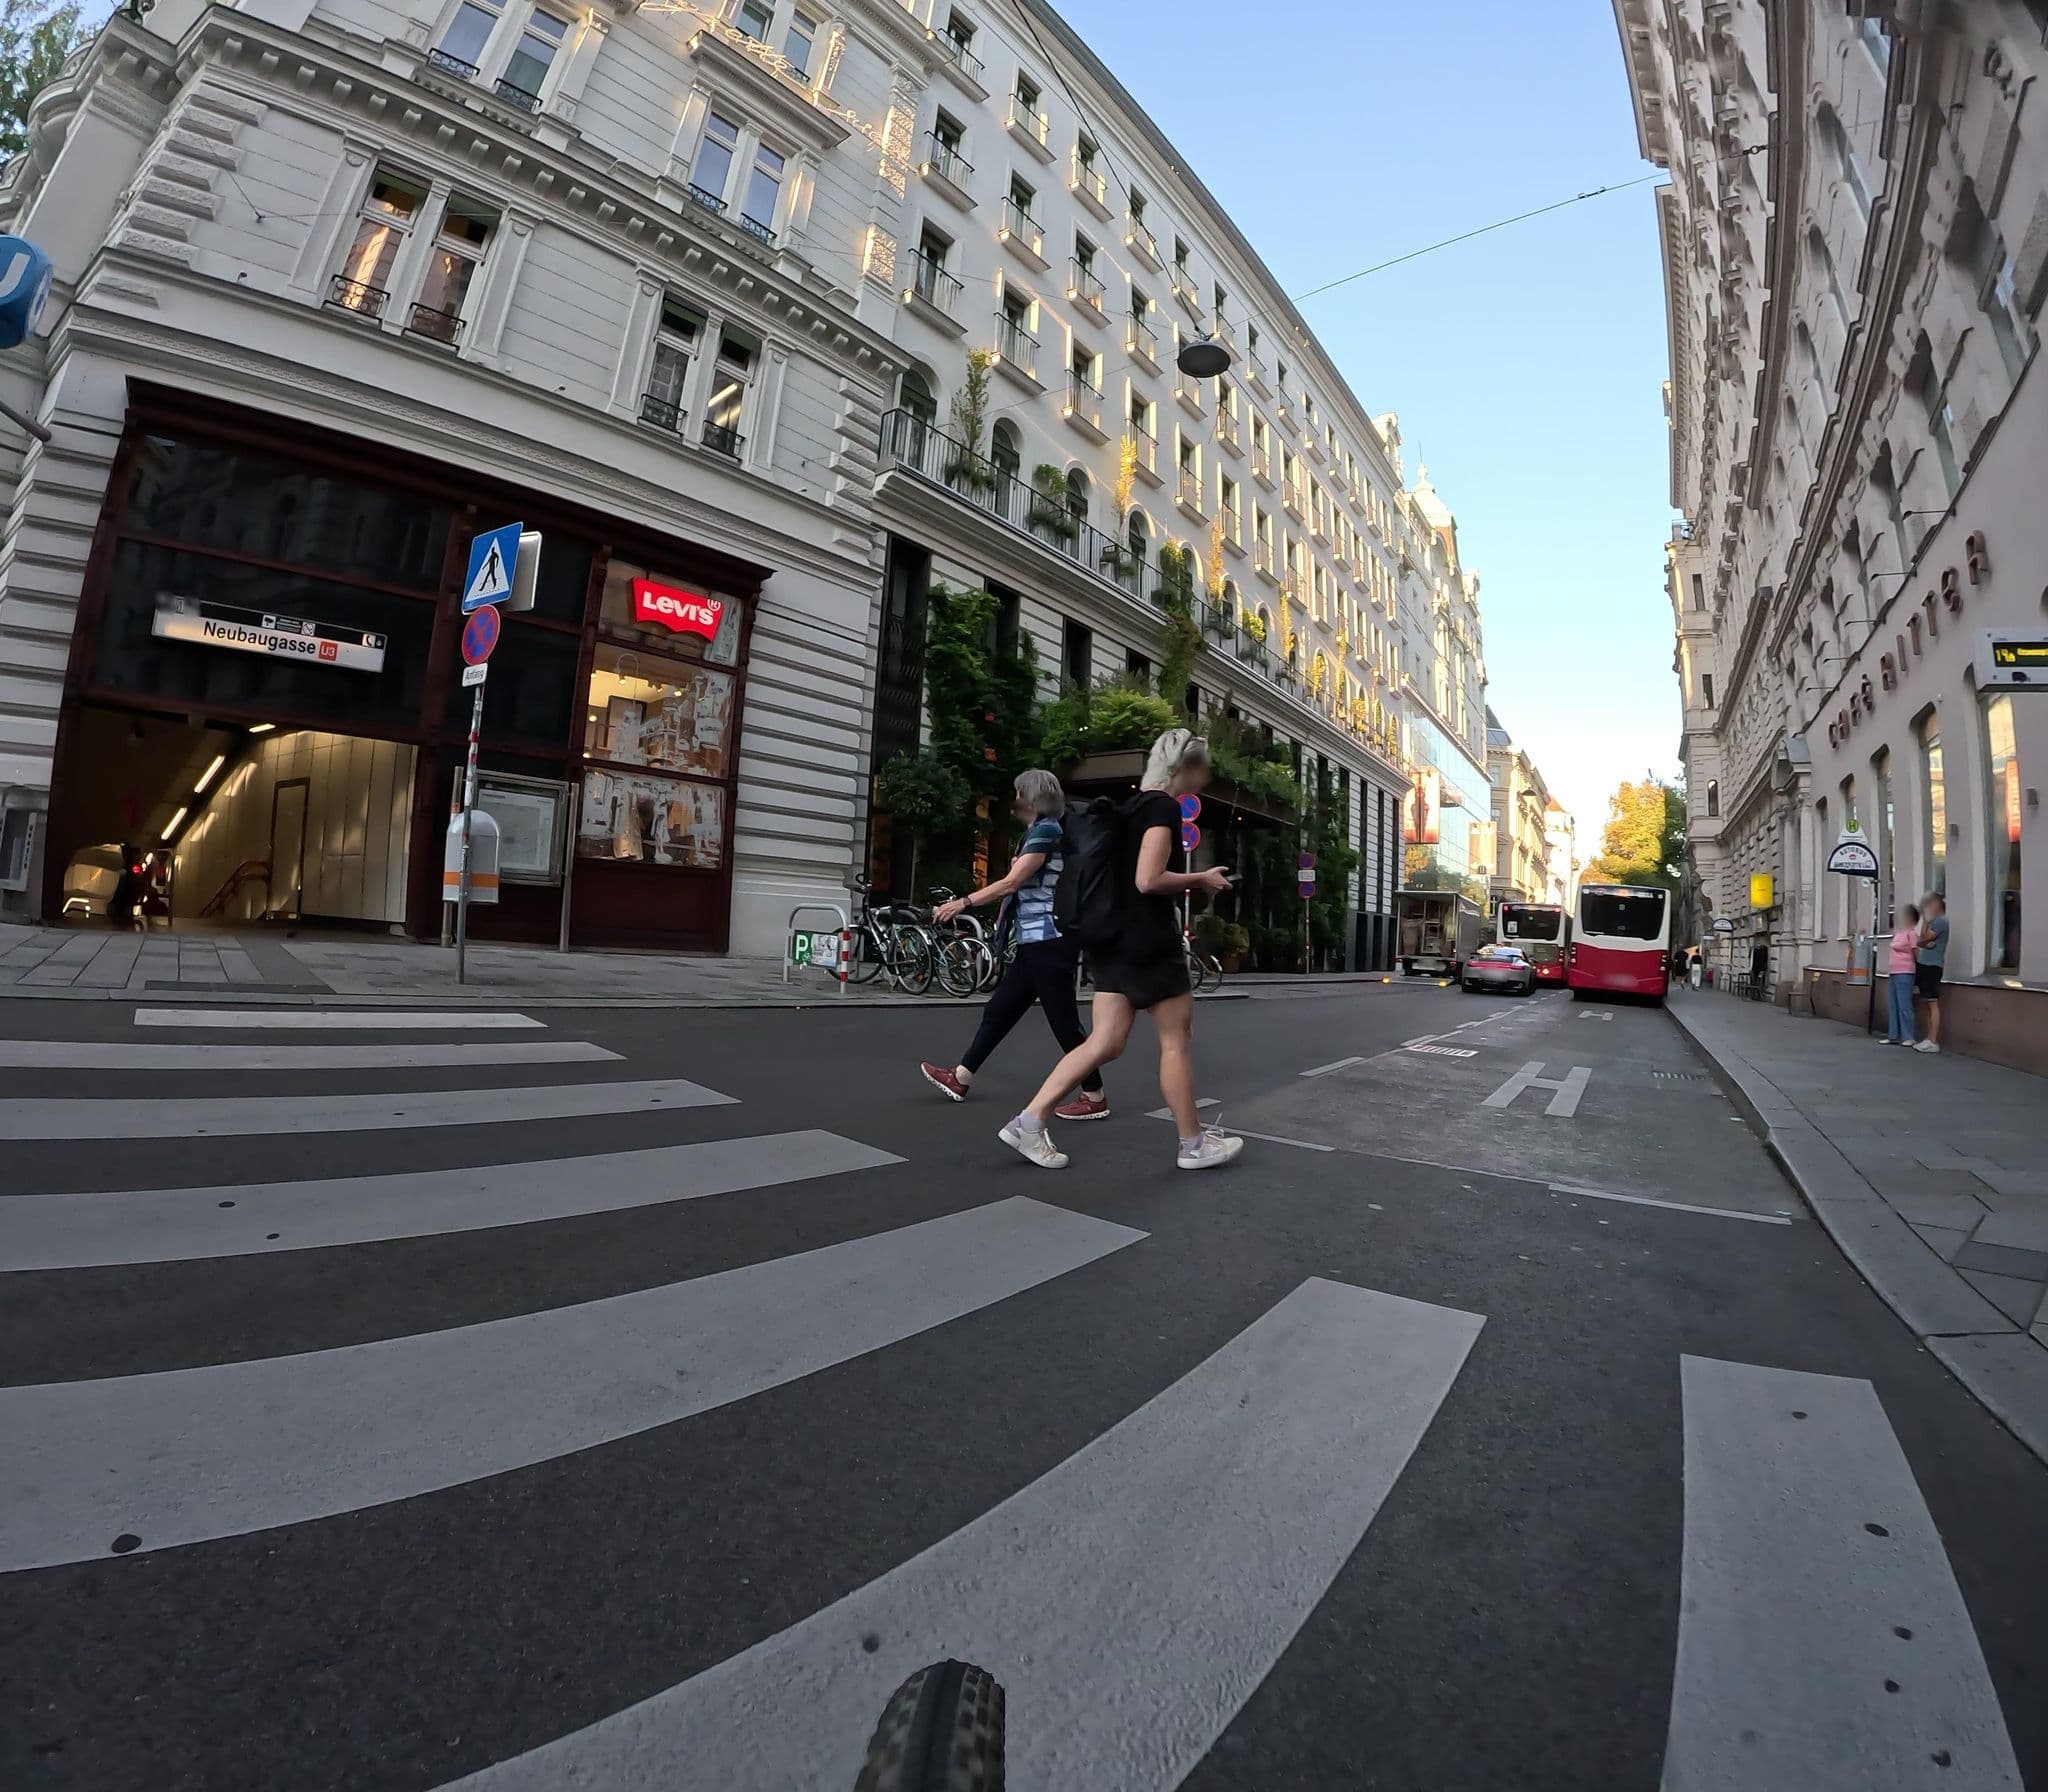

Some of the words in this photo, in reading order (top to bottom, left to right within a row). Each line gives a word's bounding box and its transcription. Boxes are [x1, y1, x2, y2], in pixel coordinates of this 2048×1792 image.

[1880, 529, 1989, 691] RITTER
[203, 621, 316, 655] Neubaugasse
[320, 643, 335, 658] U3
[795, 934, 809, 960] P
[1480, 1060, 1593, 1118] H
